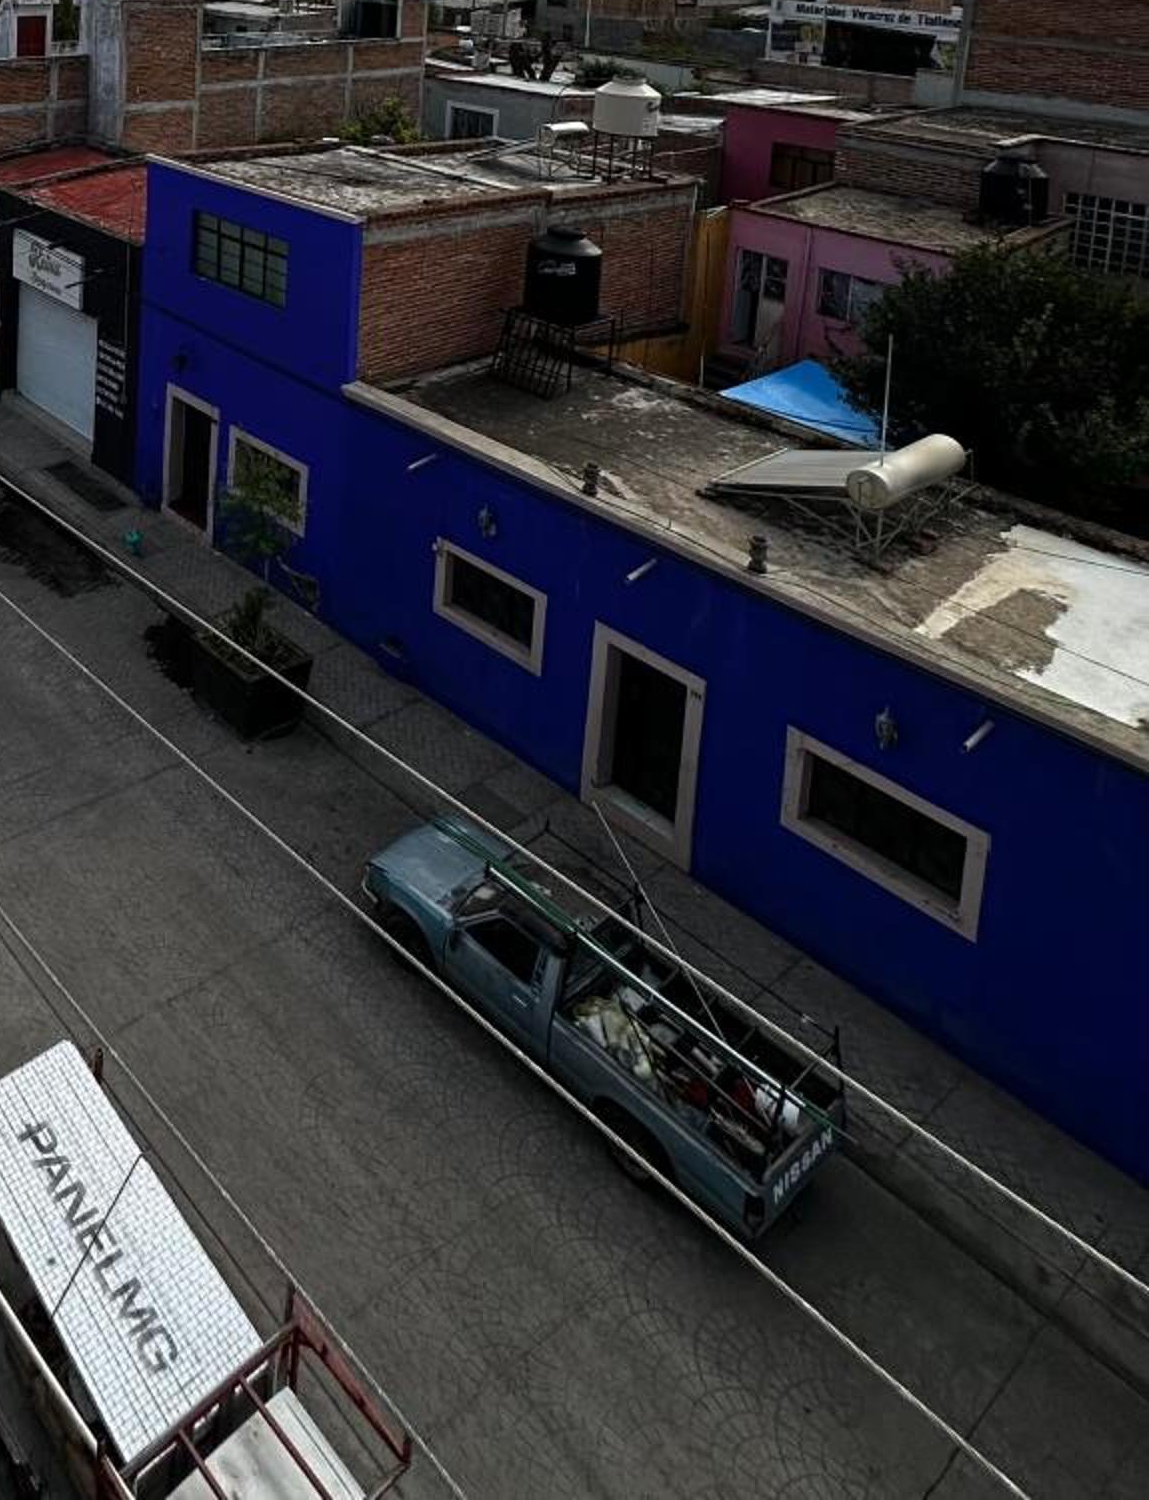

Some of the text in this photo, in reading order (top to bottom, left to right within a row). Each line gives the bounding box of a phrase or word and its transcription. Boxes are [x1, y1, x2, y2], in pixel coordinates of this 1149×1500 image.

[796, 3, 847, 17] Materiales
[852, 8, 896, 23] Veracruz
[898, 13, 912, 24] de
[773, 1127, 833, 1204] NISSAN
[17, 1120, 178, 1373] PANELMG
